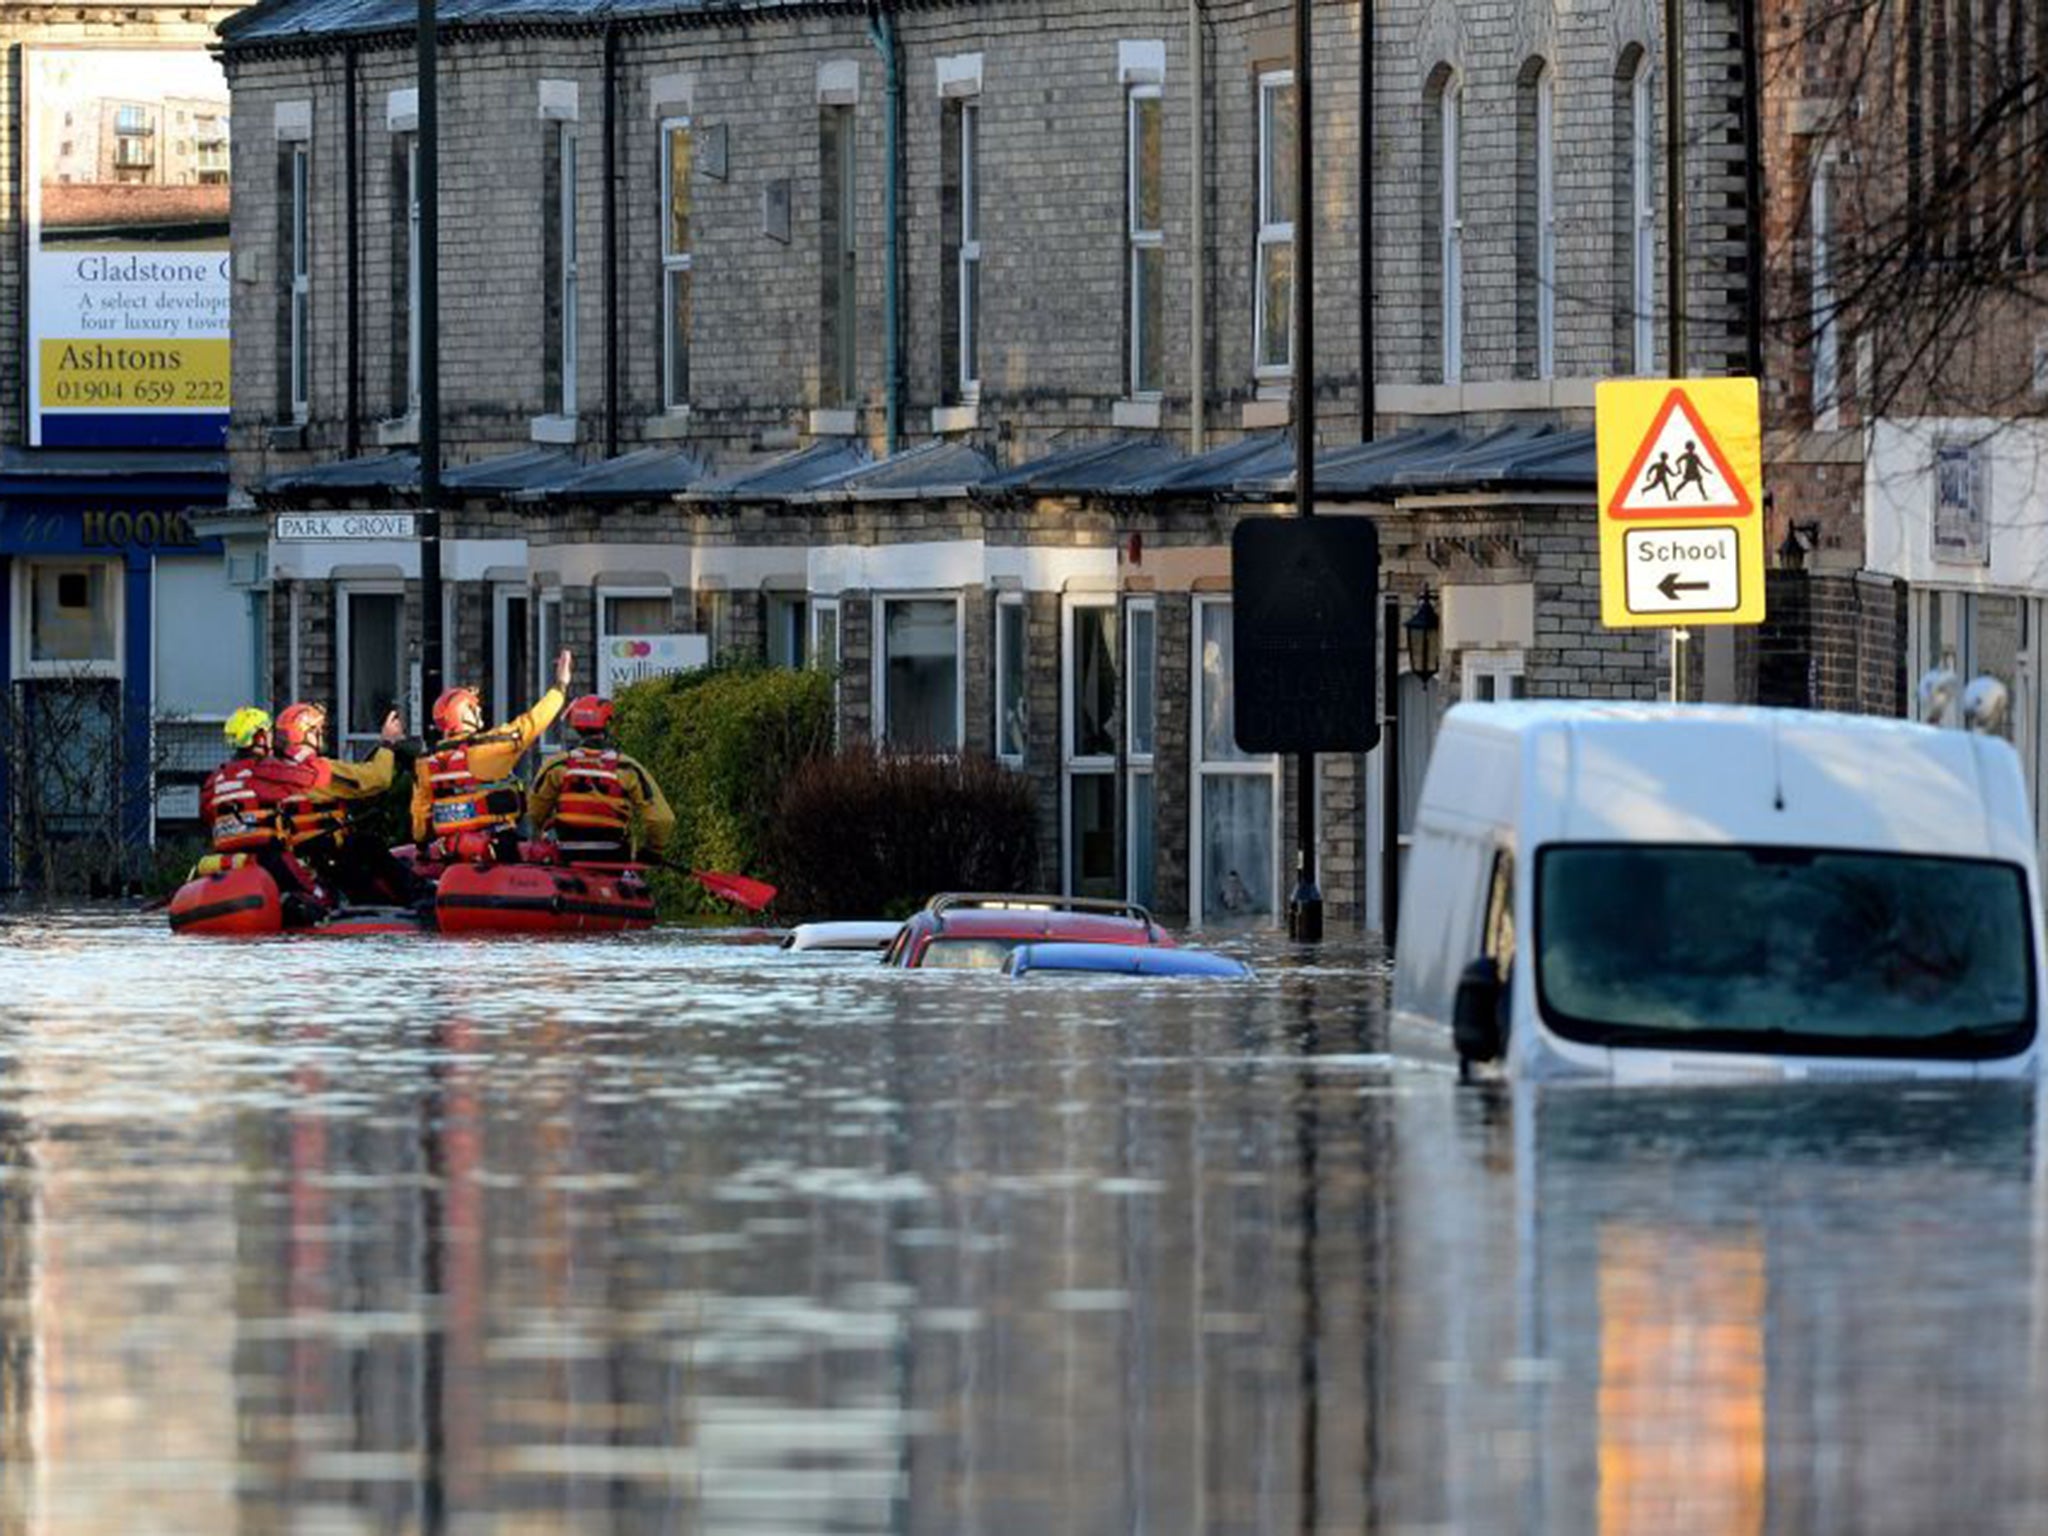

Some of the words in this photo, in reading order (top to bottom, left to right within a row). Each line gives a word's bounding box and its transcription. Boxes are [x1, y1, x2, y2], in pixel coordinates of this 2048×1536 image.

[77, 256, 206, 282] Gladstone
[79, 292, 93, 309] A
[101, 291, 147, 309] select
[81, 312, 116, 330] four
[125, 312, 179, 336] luxury
[59, 344, 182, 371] Ashtons
[57, 380, 122, 401] 01904
[134, 379, 174, 403] 659
[185, 379, 226, 401] 222
[82, 508, 198, 546] HOOK
[282, 519, 333, 536] PARK
[343, 516, 408, 536] GROVE
[1638, 538, 1726, 562] School
